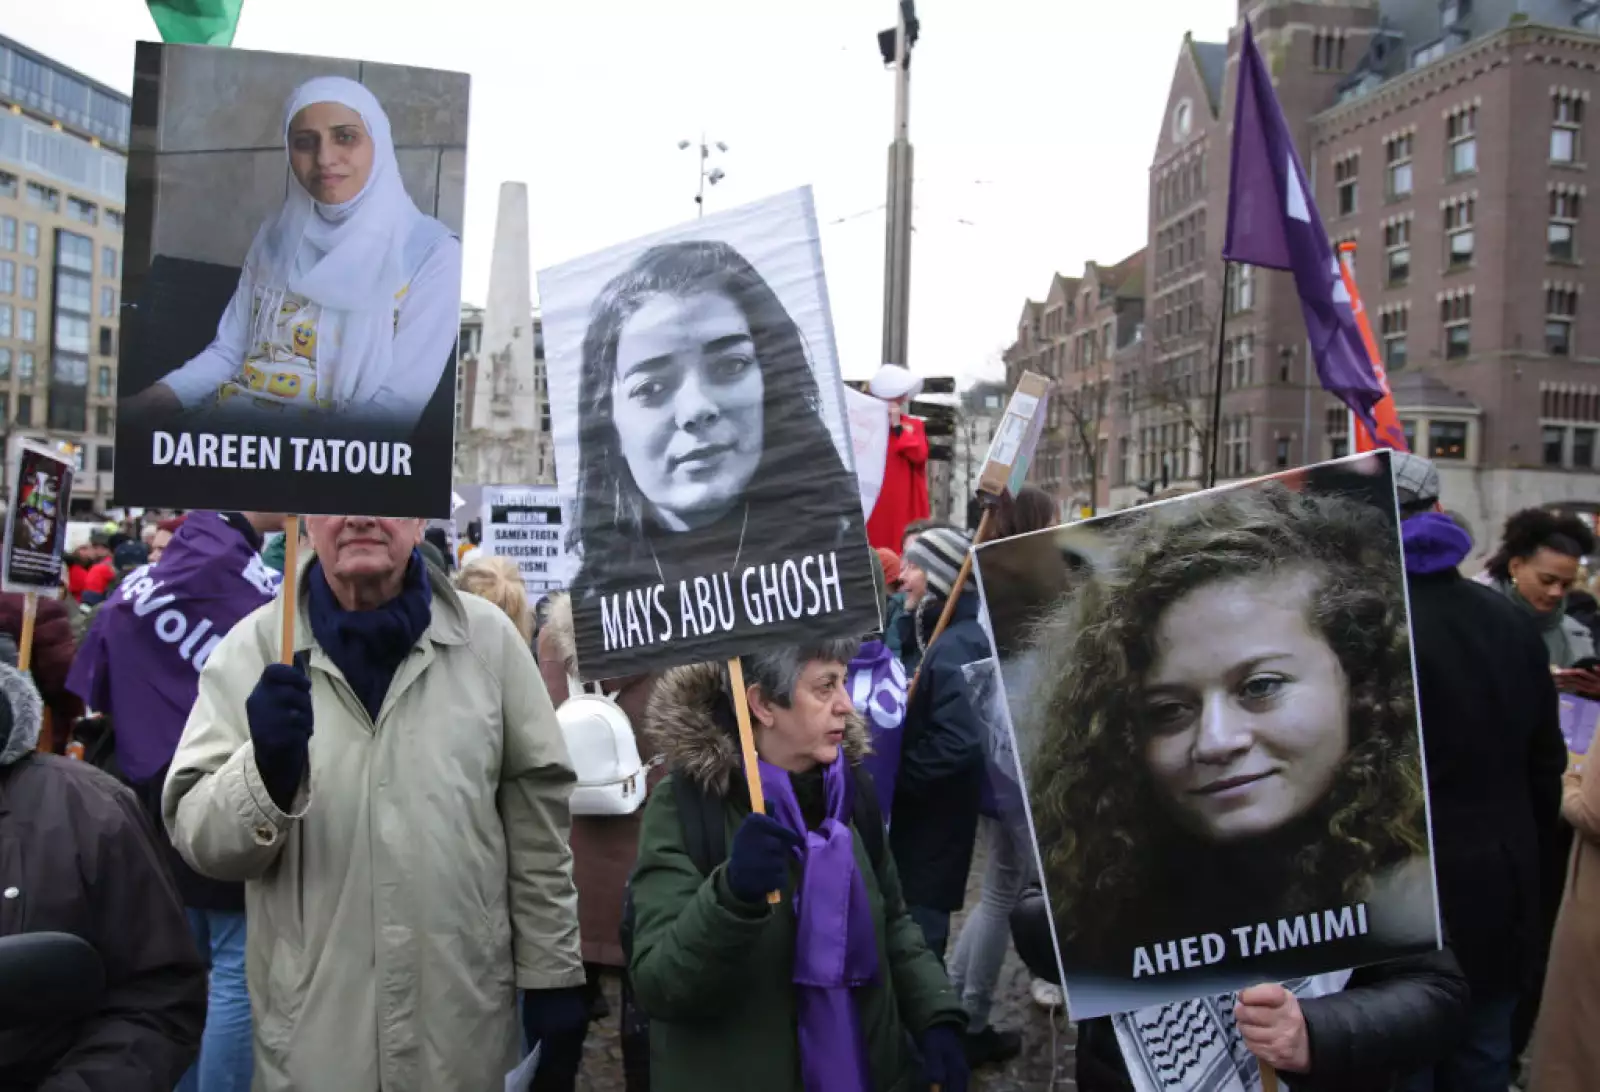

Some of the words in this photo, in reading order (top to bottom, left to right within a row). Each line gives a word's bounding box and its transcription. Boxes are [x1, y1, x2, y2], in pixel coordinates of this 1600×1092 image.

[152, 430, 281, 470] DAREEN
[290, 437, 412, 476] TATOUR
[600, 583, 672, 651] MAYS
[679, 571, 735, 638] ABU
[741, 551, 844, 626] GHOSH
[1132, 932, 1226, 979] AHED
[1231, 902, 1369, 958] TAMIMI
